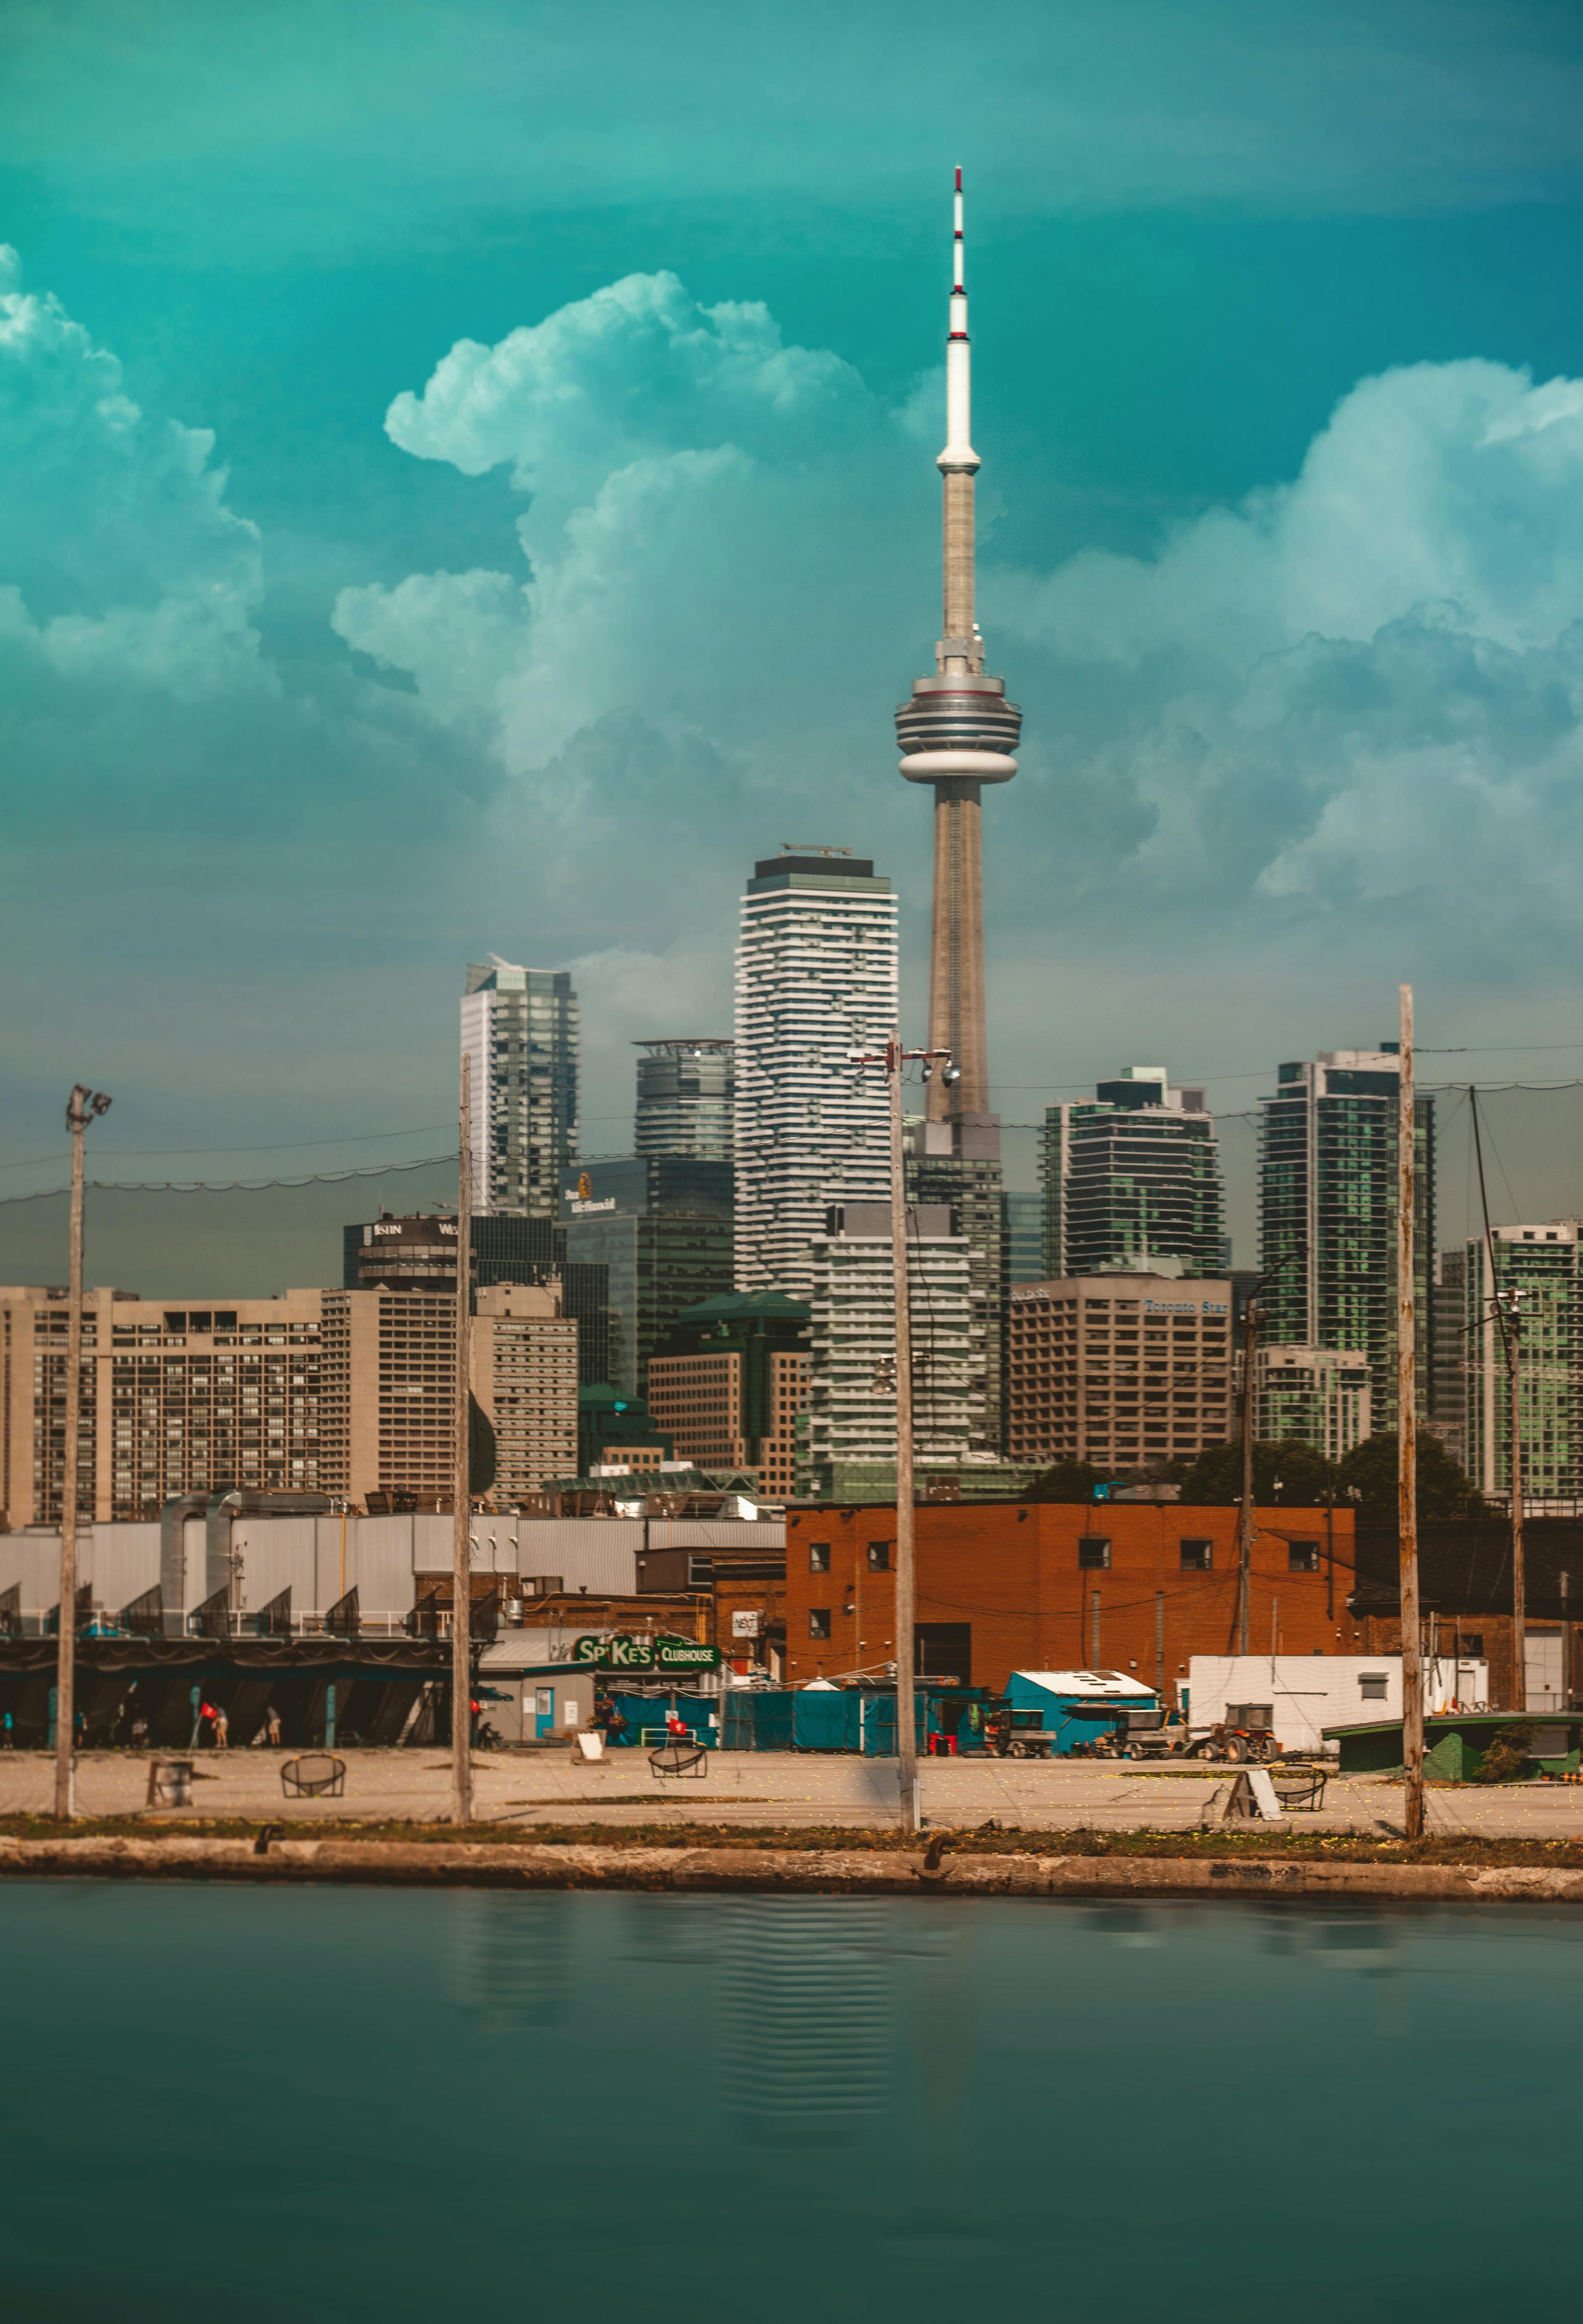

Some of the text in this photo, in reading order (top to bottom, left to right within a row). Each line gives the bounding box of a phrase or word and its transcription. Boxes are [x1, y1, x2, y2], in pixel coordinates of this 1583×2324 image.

[1144, 1299, 1228, 1313] Toronto Star
[662, 1647, 714, 1661] CLUBHOUSE
